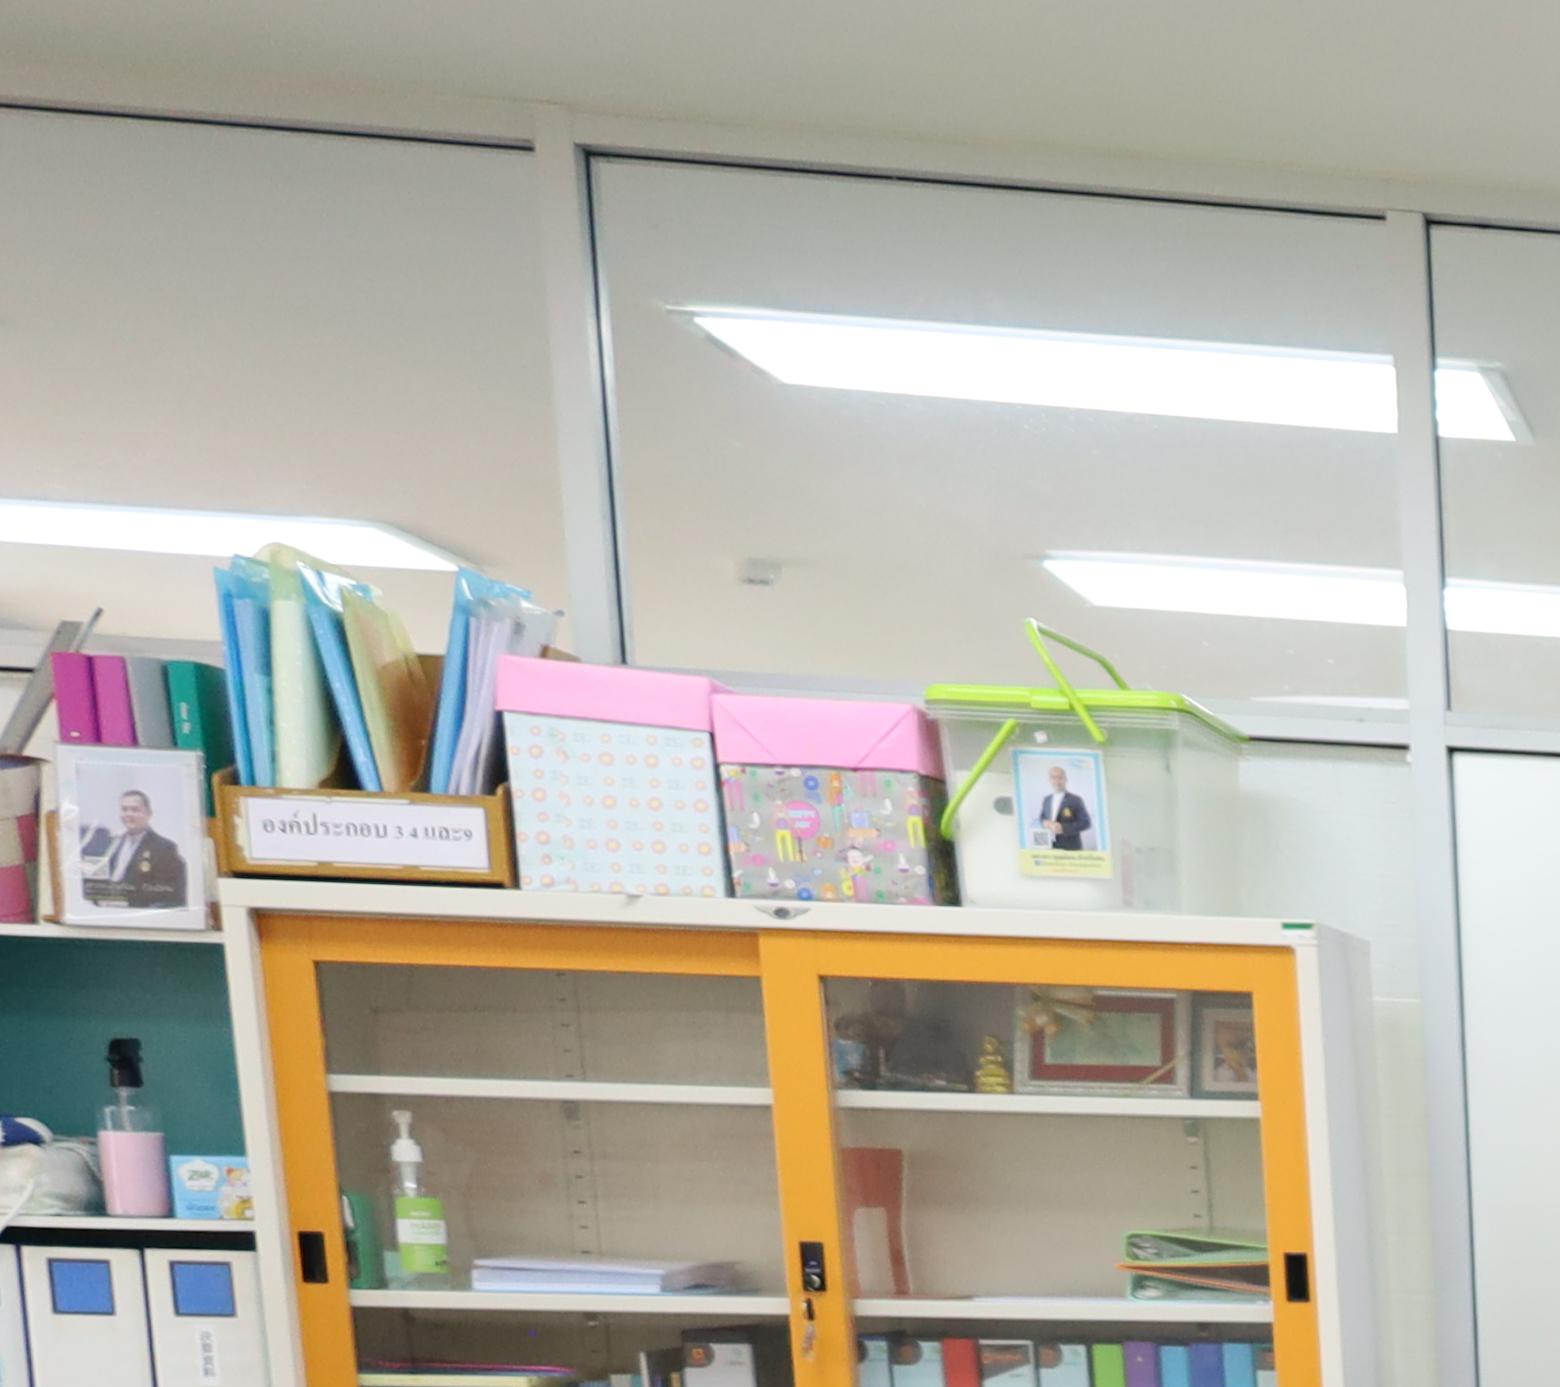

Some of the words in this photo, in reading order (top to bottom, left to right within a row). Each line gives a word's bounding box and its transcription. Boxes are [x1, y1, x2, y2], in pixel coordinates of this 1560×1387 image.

[262, 810, 387, 839] องค์ประกอบ
[394, 825, 404, 839] 3
[409, 827, 419, 840] 4
